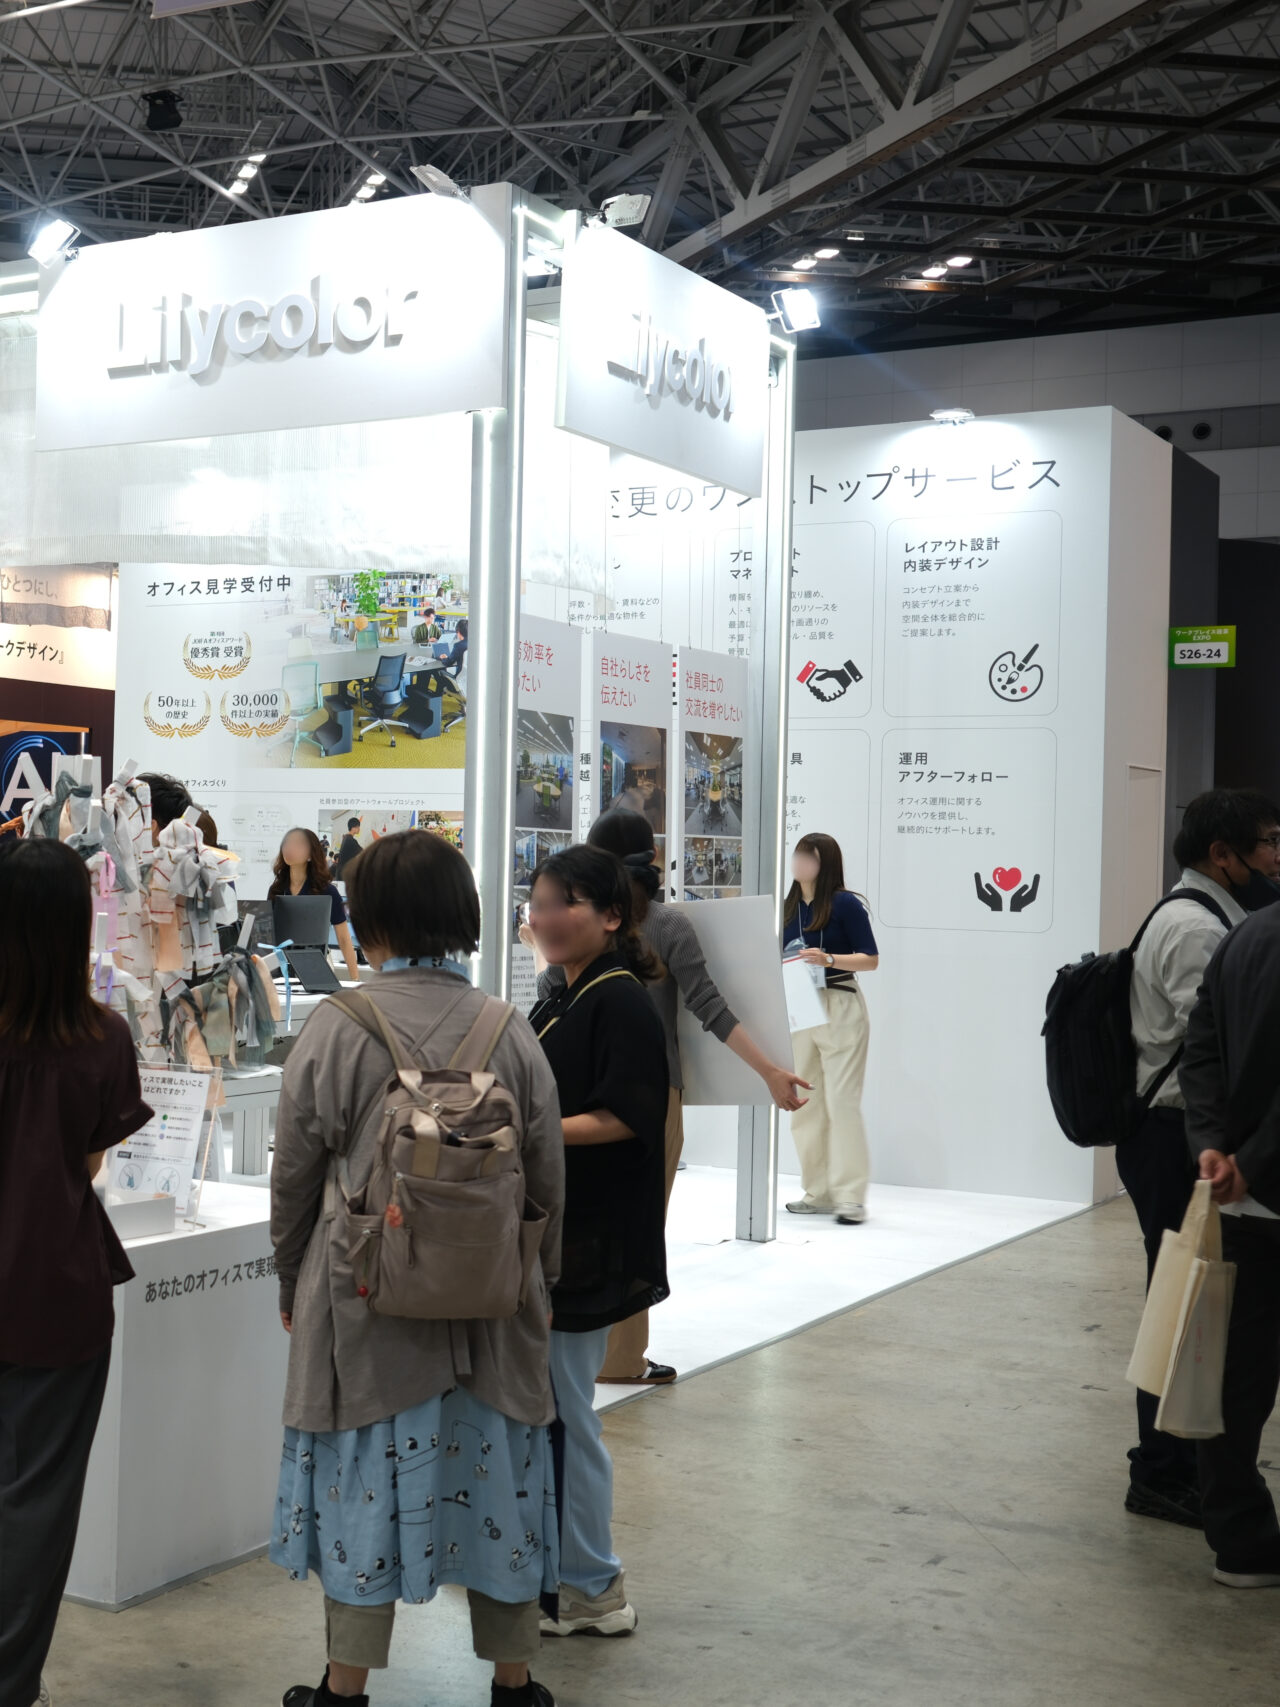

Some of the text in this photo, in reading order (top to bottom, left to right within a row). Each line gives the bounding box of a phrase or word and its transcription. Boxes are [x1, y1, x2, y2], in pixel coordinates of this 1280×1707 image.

[107, 275, 418, 386] Lilycolor
[904, 537, 1000, 554] レイアウト設計
[903, 557, 989, 573] 内装デザイン
[147, 574, 291, 597] オフィス見学受付中
[903, 584, 980, 594] コンセプト立案から
[902, 598, 971, 609] 内装デザインまで
[902, 612, 985, 624] 空間全体を総合的に
[902, 628, 956, 638] ご提案します。
[190, 645, 244, 659] 優秀賞 受賞
[1179, 648, 1221, 659] S26-24
[600, 656, 651, 683] 自社らしさを
[685, 671, 724, 693] 社員同士の
[158, 695, 197, 708] 50年以上
[232, 693, 278, 707] 30,000
[600, 684, 637, 708] 伝えたい
[165, 710, 189, 720] の歴史
[230, 708, 279, 718] 件以上の実績
[685, 698, 744, 722] 交流を増やしたい
[898, 752, 928, 765] 運用
[898, 770, 1009, 783] アフターフォロー
[183, 779, 227, 788] オフィスづくり
[897, 797, 982, 806] オフィス運用に関する
[897, 811, 969, 821] ノウハウを提供し、
[897, 825, 995, 836] 継続的にサポートします。
[145, 1255, 278, 1303] あなたのオフィスで実現
